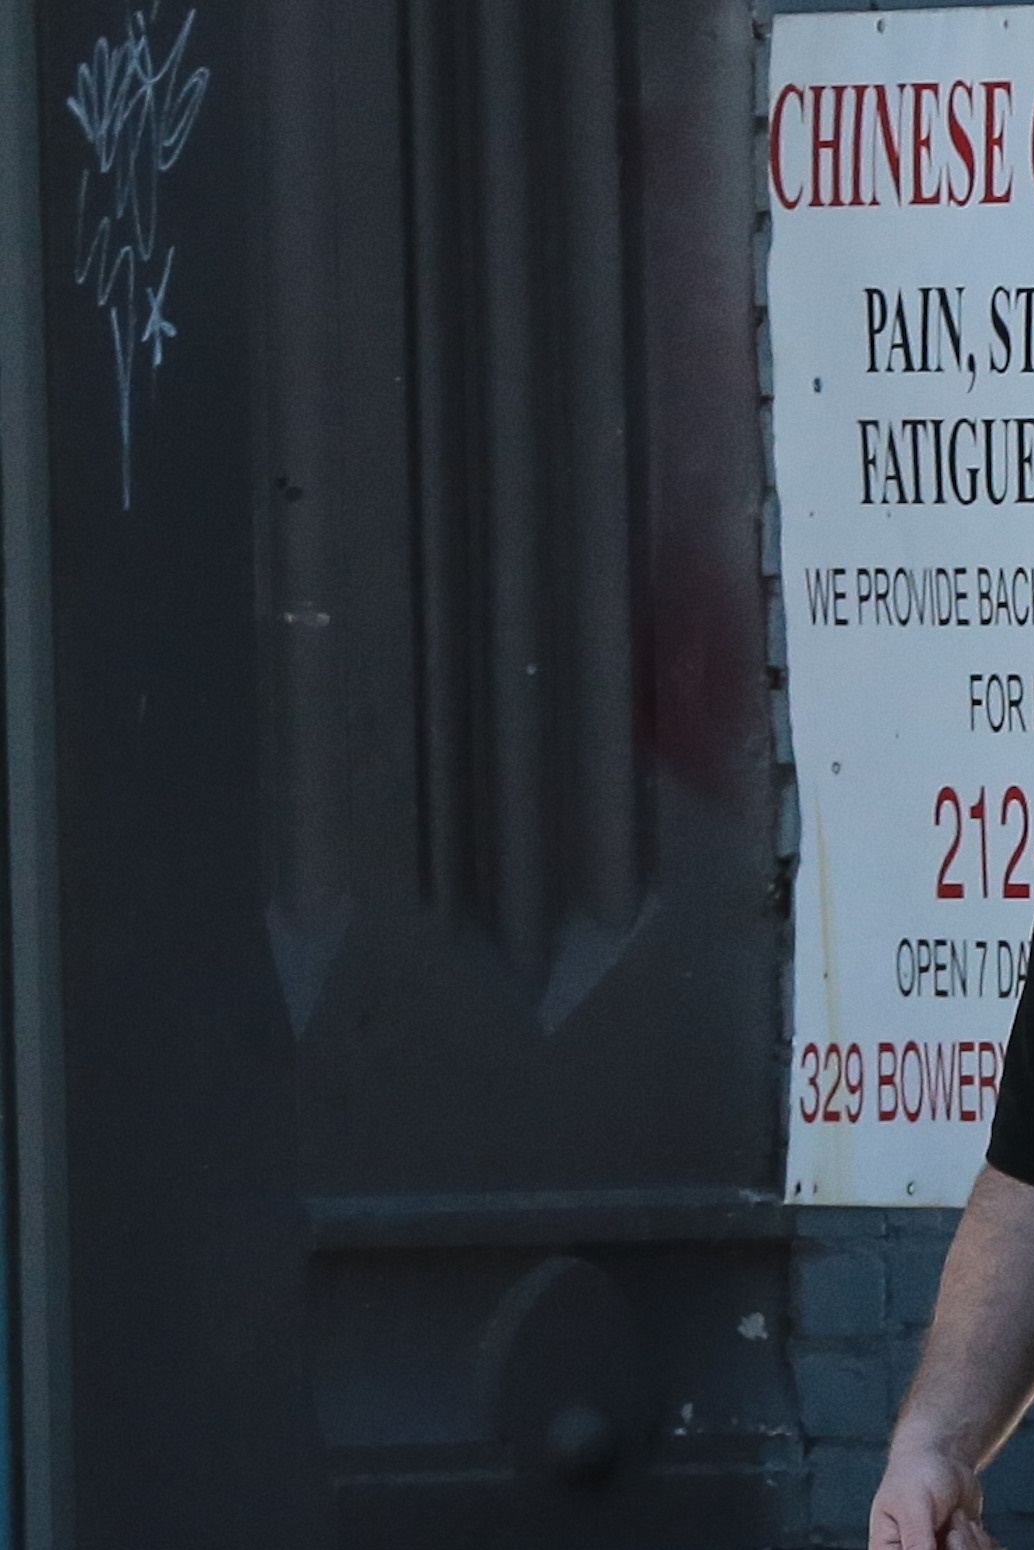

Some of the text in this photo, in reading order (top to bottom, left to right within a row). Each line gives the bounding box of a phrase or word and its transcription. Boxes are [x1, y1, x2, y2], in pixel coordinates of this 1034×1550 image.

[769, 81, 1012, 210] CHINESE
[864, 286, 977, 392] PAIN,
[806, 567, 849, 626] WE
[856, 567, 970, 627] PROVIDE
[969, 673, 1025, 733] FOR
[896, 937, 1032, 998] OPEN 7 DA
[800, 1042, 864, 1123] 329
